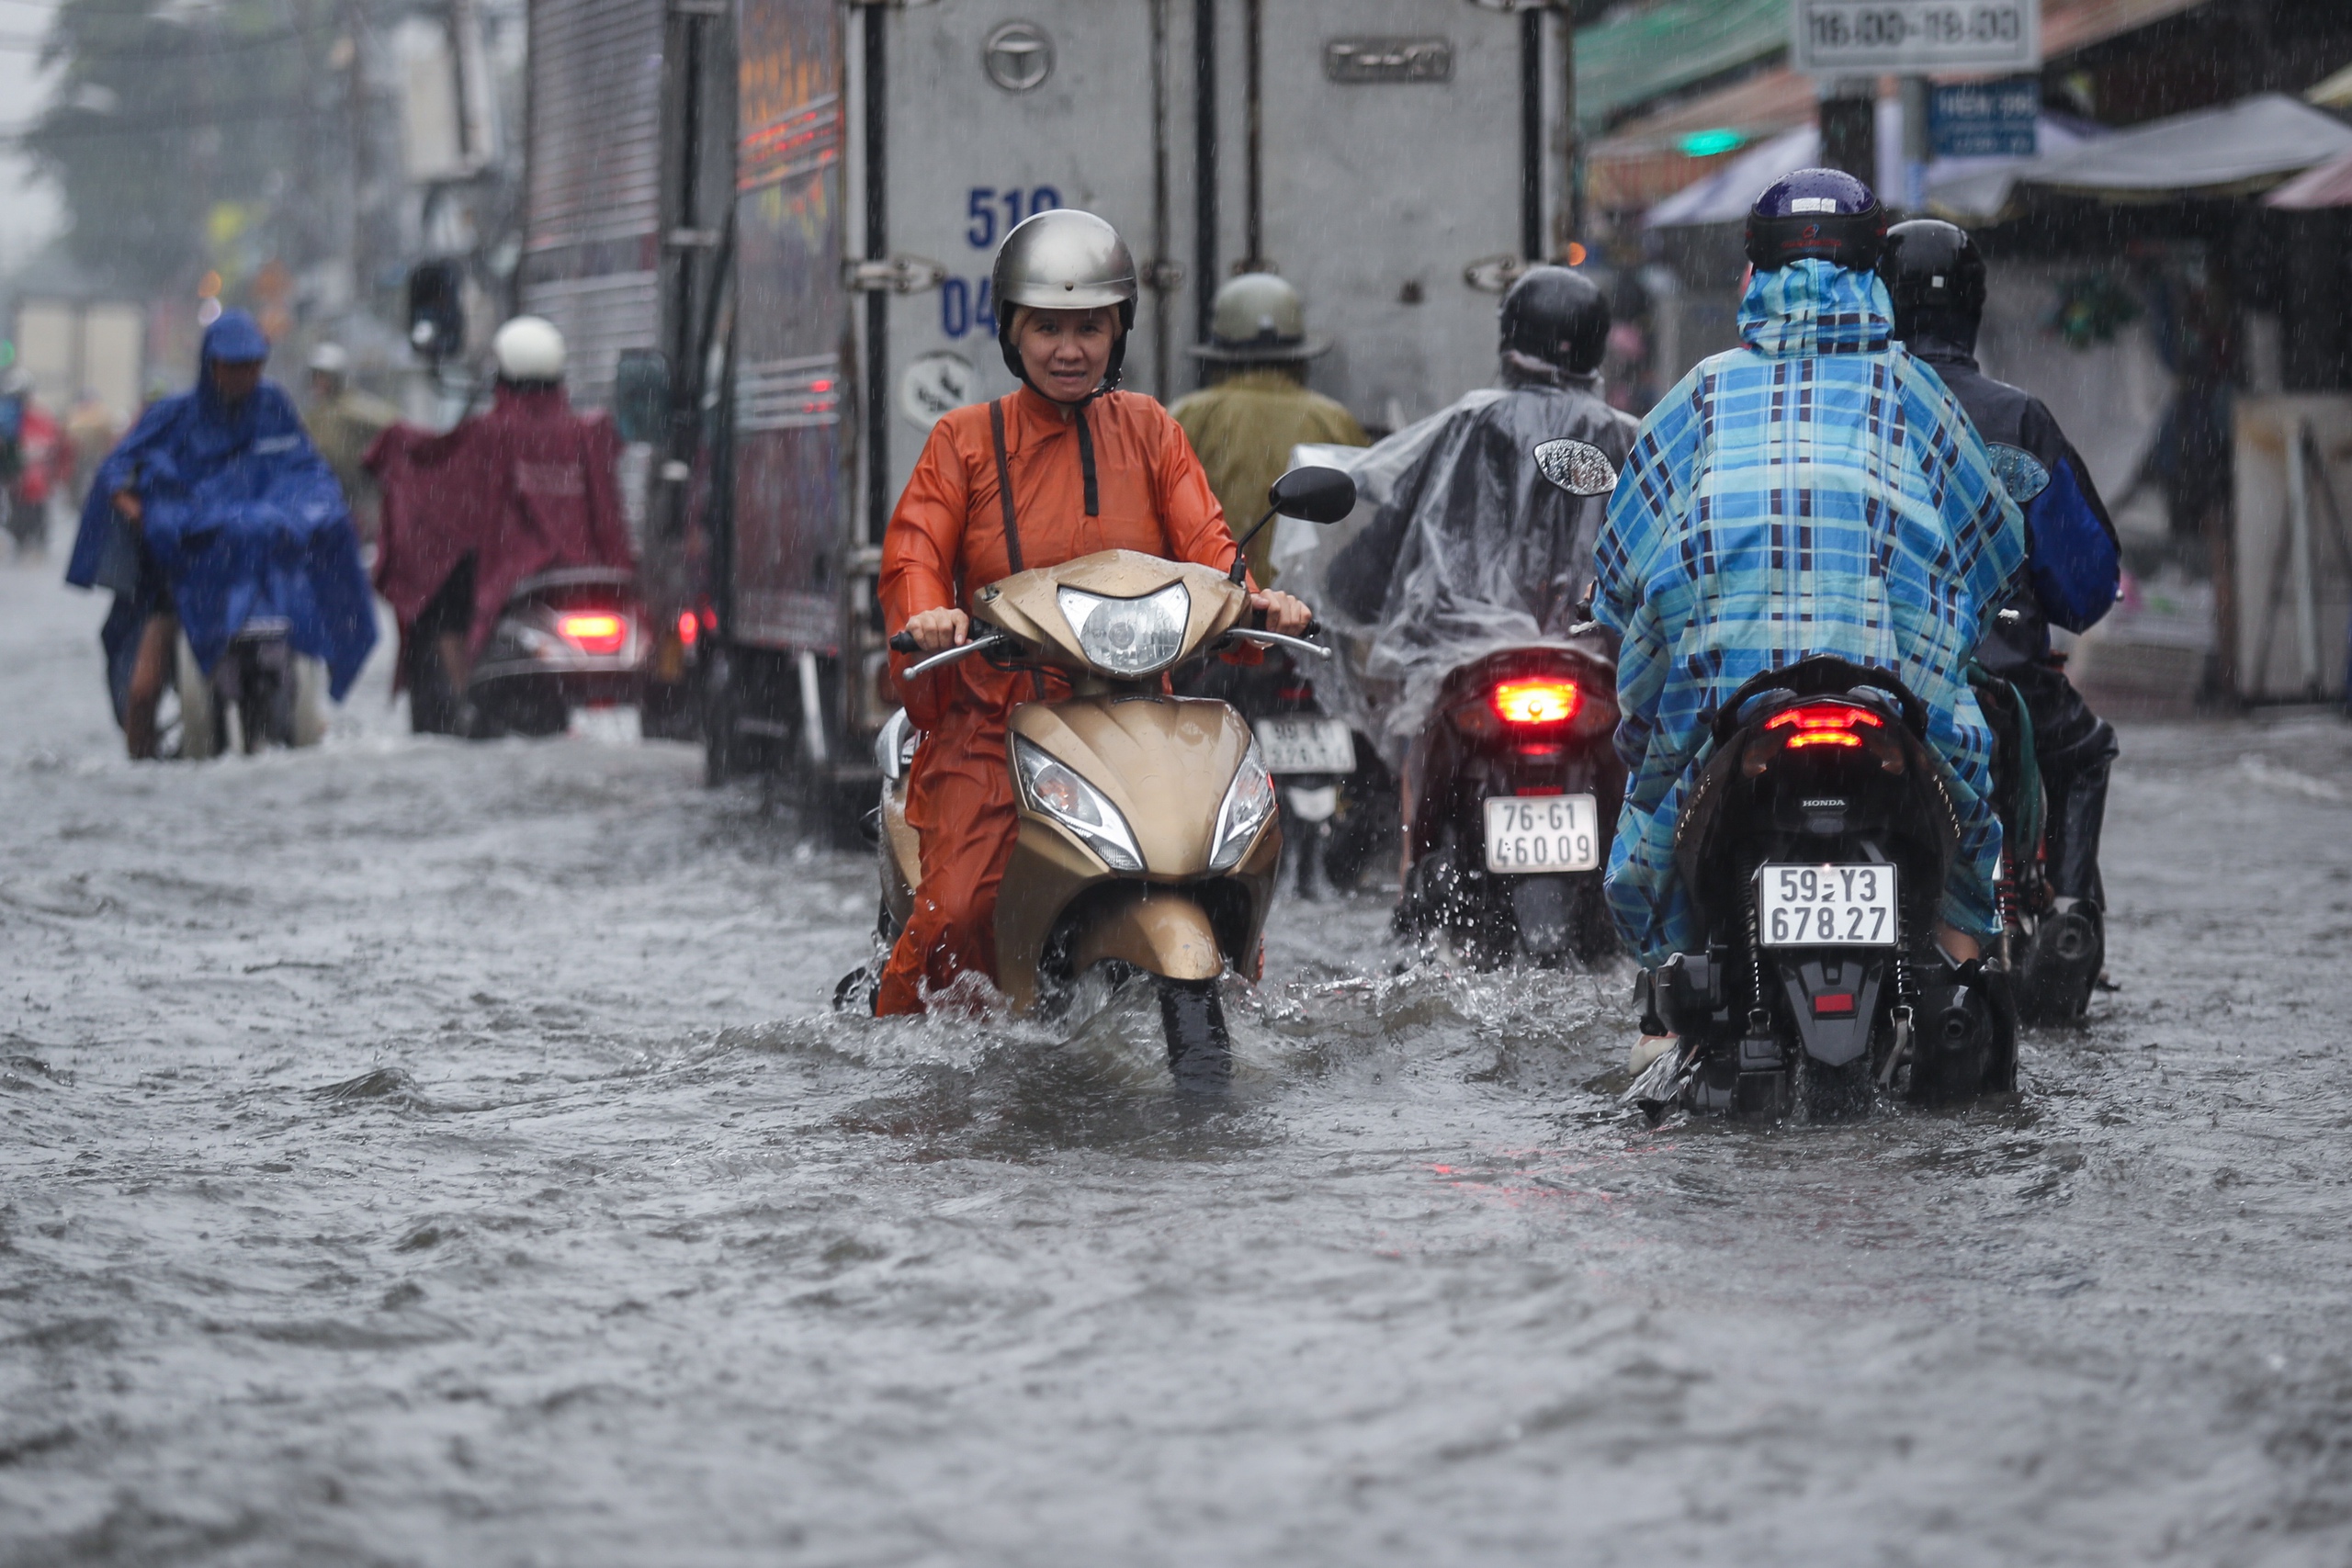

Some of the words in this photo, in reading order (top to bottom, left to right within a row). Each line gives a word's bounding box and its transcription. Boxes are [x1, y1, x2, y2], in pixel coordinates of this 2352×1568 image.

[1802, 798, 1846, 807] HONDA
[1497, 834, 1590, 868] 460.09
[1780, 869, 1877, 903] 59-Y3
[1771, 907, 1887, 942] 678.27
